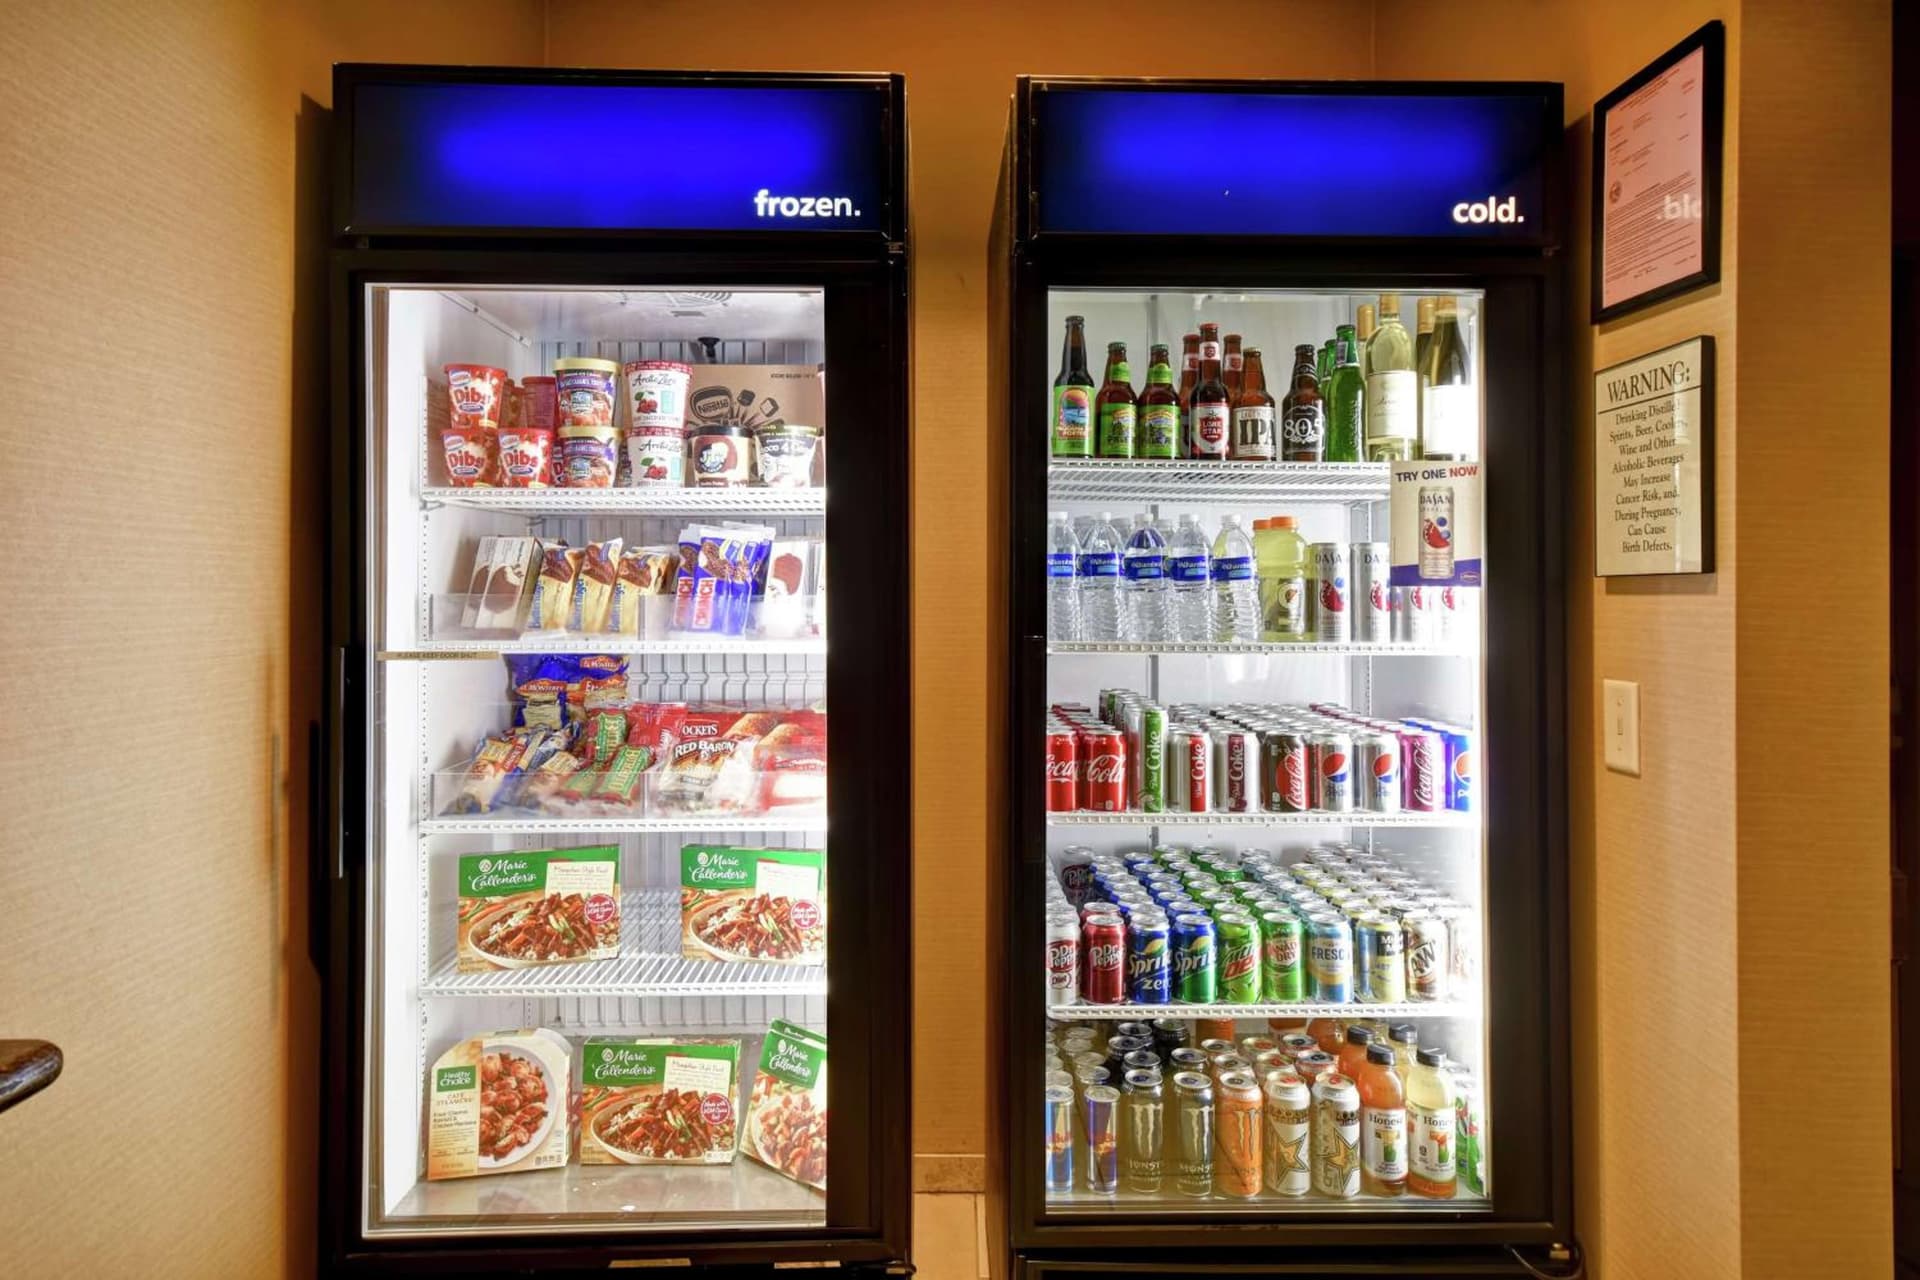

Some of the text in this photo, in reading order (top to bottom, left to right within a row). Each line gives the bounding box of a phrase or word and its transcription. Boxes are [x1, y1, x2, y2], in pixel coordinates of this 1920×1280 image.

[754, 189, 861, 217] frozen.
[1453, 196, 1524, 223] cold.
[1607, 360, 1690, 403] WARNING:
[1615, 409, 1647, 425] Drinking
[1239, 418, 1276, 445] IPA
[1609, 431, 1634, 445] Spirits,
[1635, 425, 1654, 437] Beer,
[1619, 435, 1676, 456] Wine and Other
[448, 450, 486, 468] Dibs
[503, 450, 538, 468] Dibs
[1613, 454, 1684, 474] Alcoholic Beverages
[1396, 466, 1478, 483] TRY ONE NOW
[1623, 472, 1672, 488] May Increase
[1615, 493, 1640, 505] Cancer
[1642, 488, 1662, 502] Risk,
[1615, 507, 1681, 521] During Pregnancy,
[1627, 523, 1667, 537] Can Cause
[1622, 539, 1672, 553] Birth Defects.
[675, 740, 735, 758] RED BARON
[1146, 731, 1161, 770] Coke
[1191, 744, 1205, 780] Coke
[1229, 744, 1244, 781] Coke
[490, 859, 528, 874] Marie
[707, 855, 739, 868] Marie
[1049, 948, 1077, 969] Pepp
[1090, 947, 1126, 967] Pepp
[1174, 949, 1214, 976] Spri
[1311, 947, 1346, 961] FRESC
[1129, 950, 1171, 978] Sprit
[613, 1050, 647, 1065] Marie
[439, 1077, 471, 1087] Choice
[443, 1071, 471, 1081] Healthy
